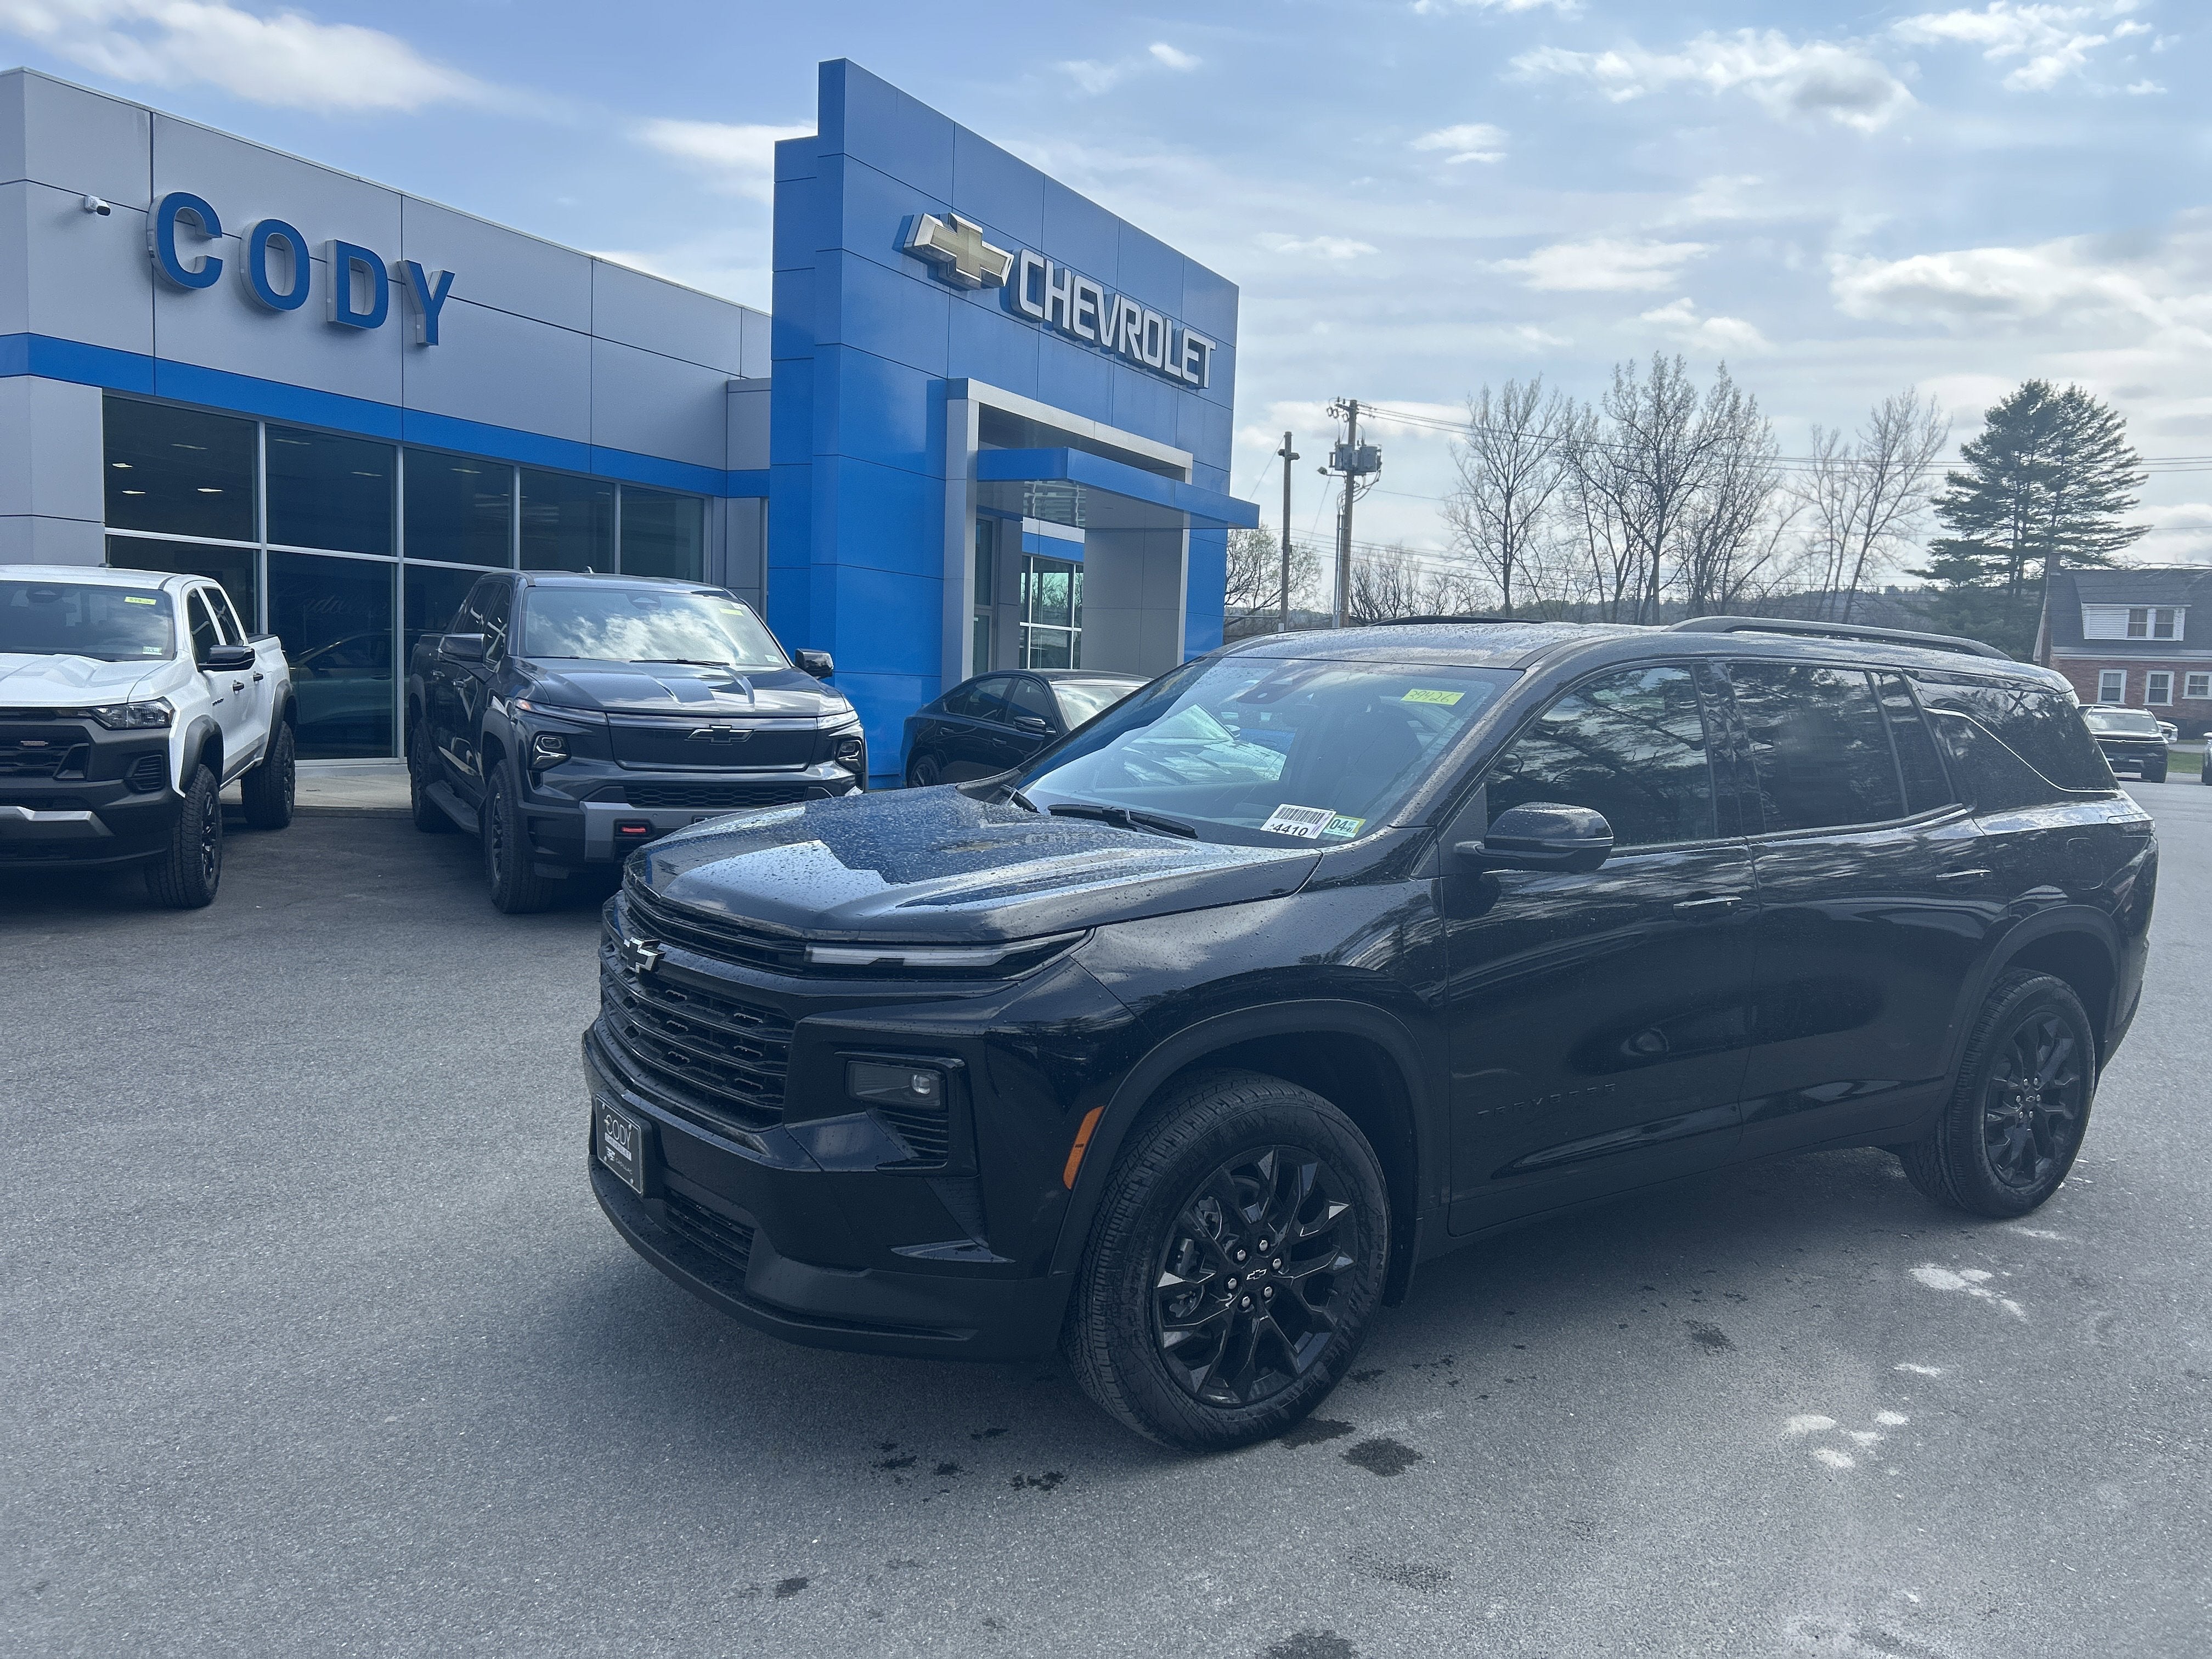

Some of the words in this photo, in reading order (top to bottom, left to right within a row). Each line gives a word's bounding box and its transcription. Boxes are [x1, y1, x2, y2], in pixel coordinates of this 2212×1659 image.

[147, 191, 456, 346] CODY
[1014, 249, 1217, 390] CHEVROLET
[1406, 690, 1454, 703] 39426
[1272, 823, 1308, 837] 4410
[1329, 819, 1348, 831] 04
[605, 1114, 631, 1150] CODY
